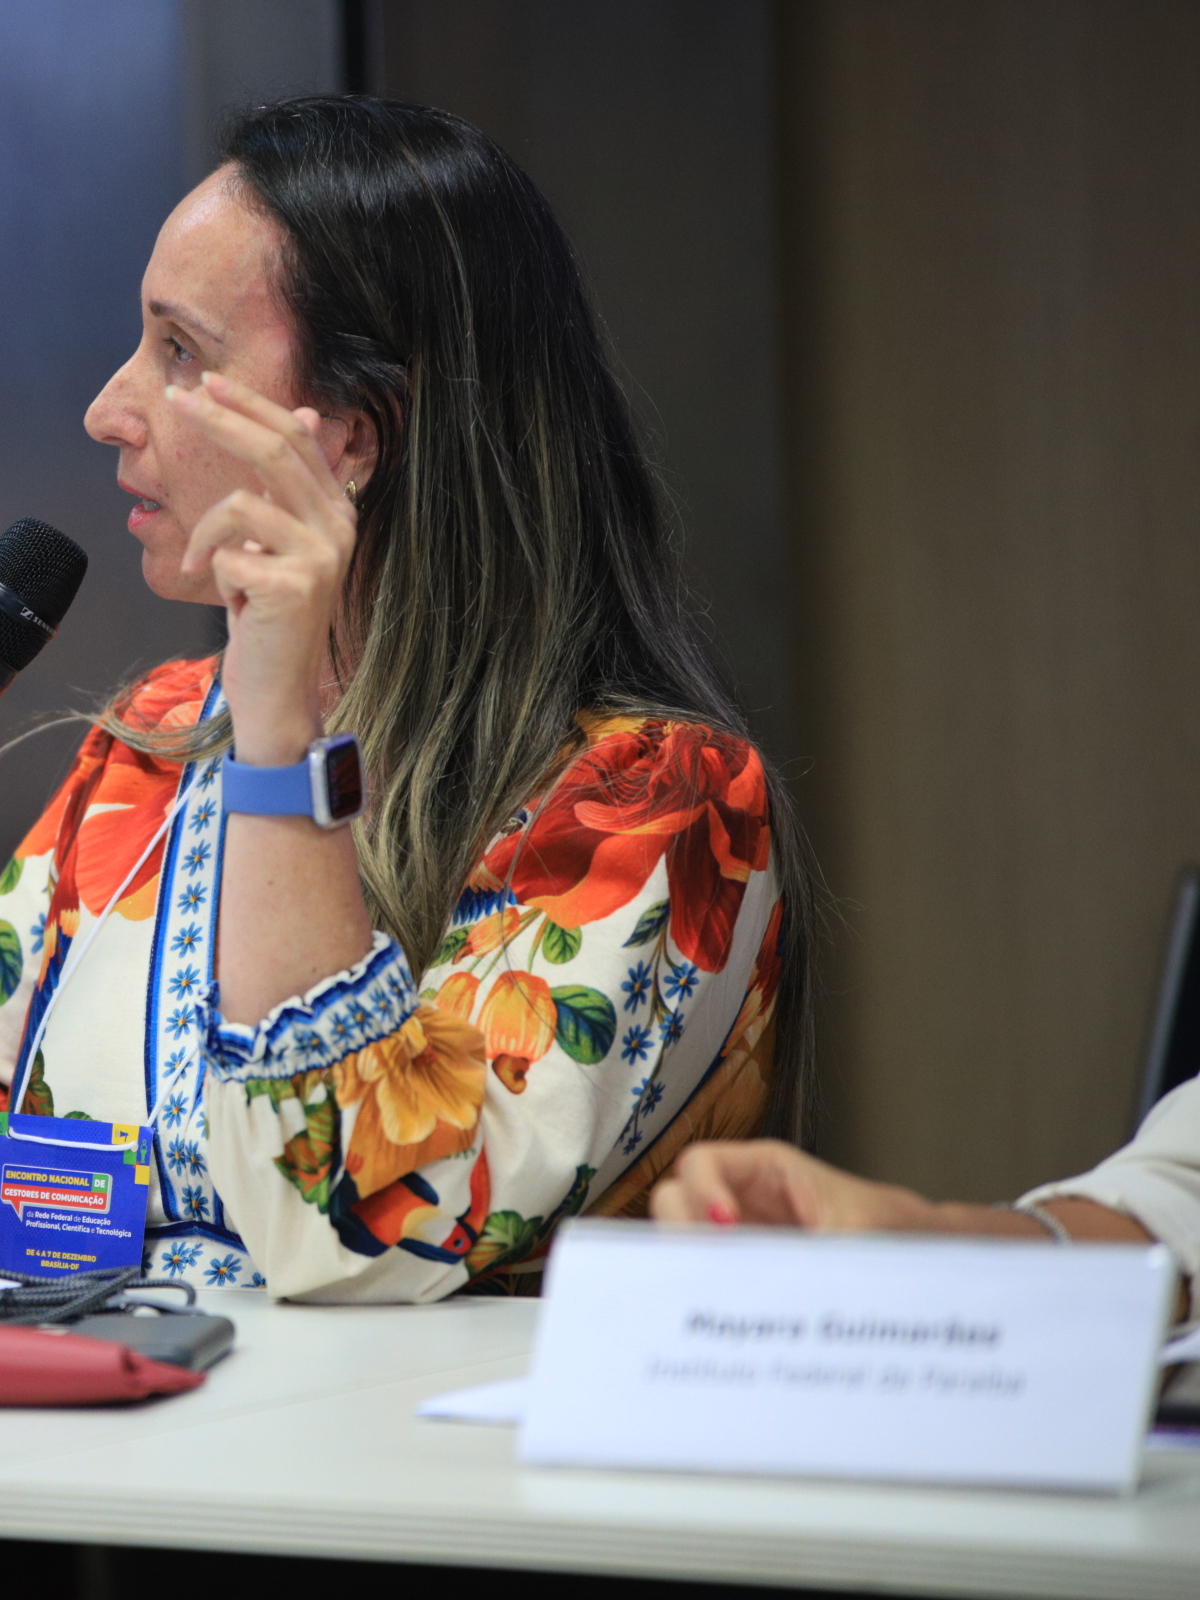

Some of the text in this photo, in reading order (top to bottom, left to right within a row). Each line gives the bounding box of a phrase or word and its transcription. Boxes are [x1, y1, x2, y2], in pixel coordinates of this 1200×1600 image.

[5, 1170, 105, 1188] ENCONTRO NACIONAL DE
[4, 1188, 104, 1206] GESTORES DE COMUNICAÇÃO
[34, 1211, 50, 1219] Rede
[51, 1213, 73, 1221] Federal
[82, 1216, 111, 1226] Educação
[26, 1220, 61, 1231] Profissional,
[61, 1224, 90, 1233] Científica
[96, 1227, 132, 1238] Tecnológica
[41, 1260, 79, 1270] BRASÍLIA-DF
[62, 1252, 96, 1262] DEZEMBRO
